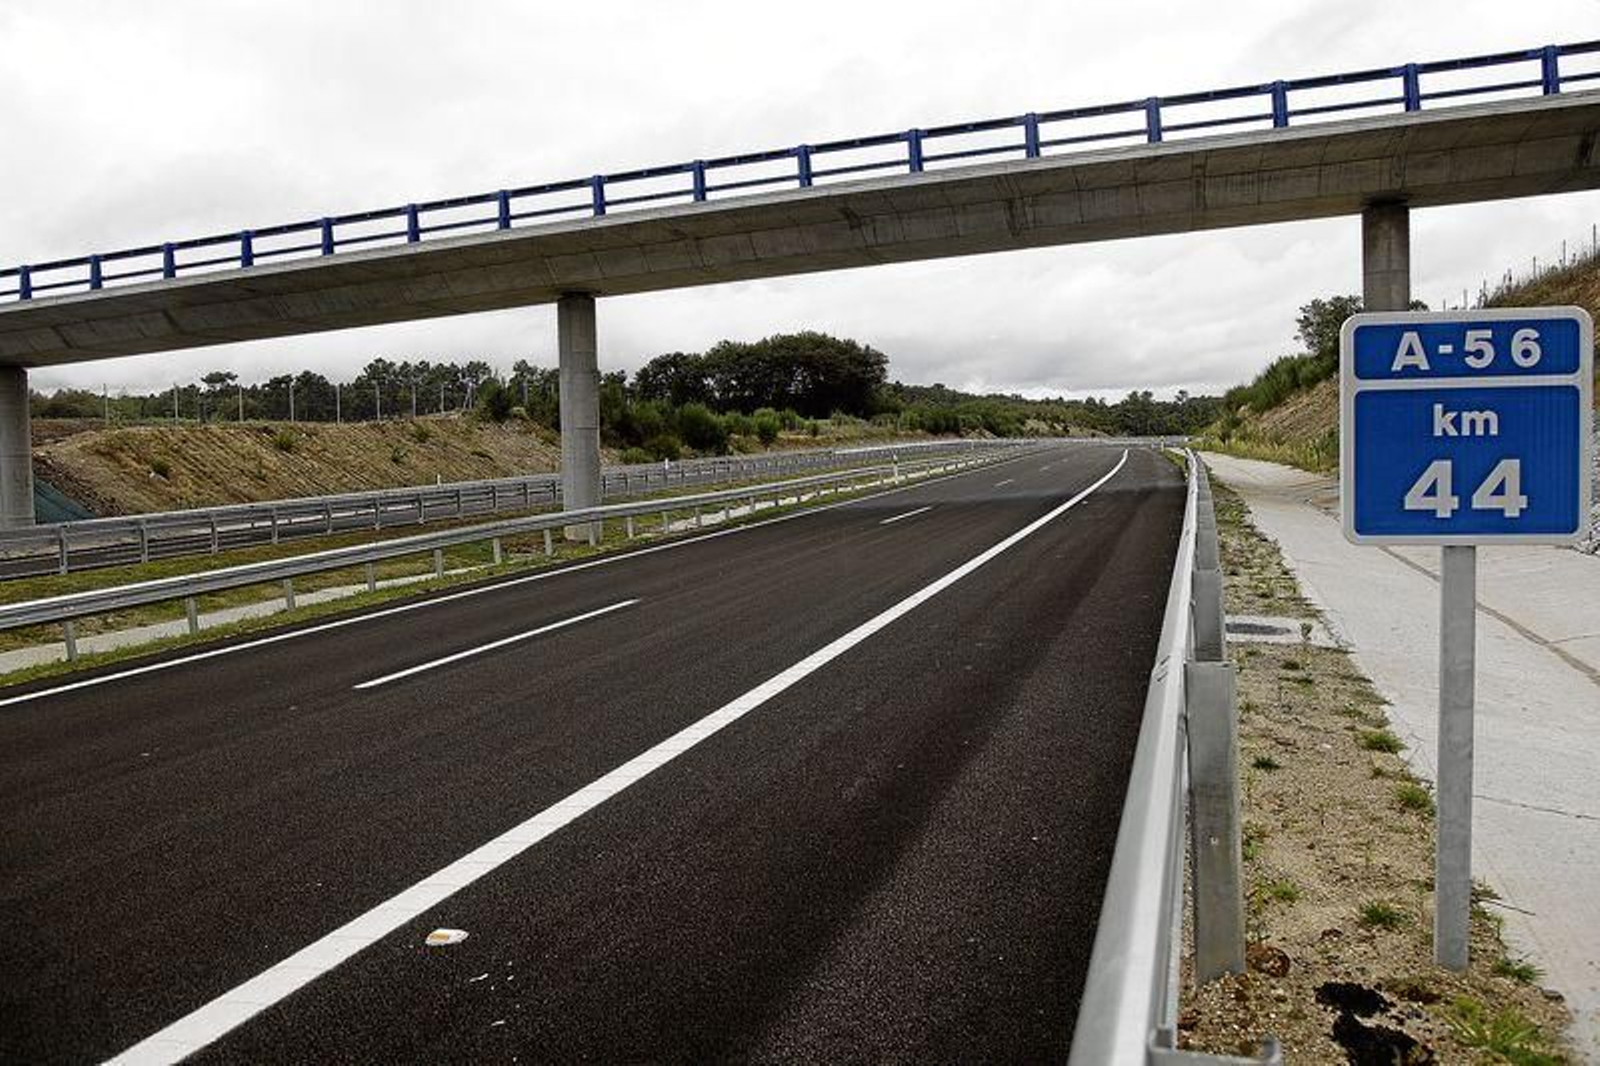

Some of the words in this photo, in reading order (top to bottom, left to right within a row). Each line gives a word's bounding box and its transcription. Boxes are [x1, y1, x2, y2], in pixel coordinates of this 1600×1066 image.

[1391, 328, 1542, 372] A-56
[1433, 403, 1499, 436] km
[1404, 458, 1528, 518] 44
